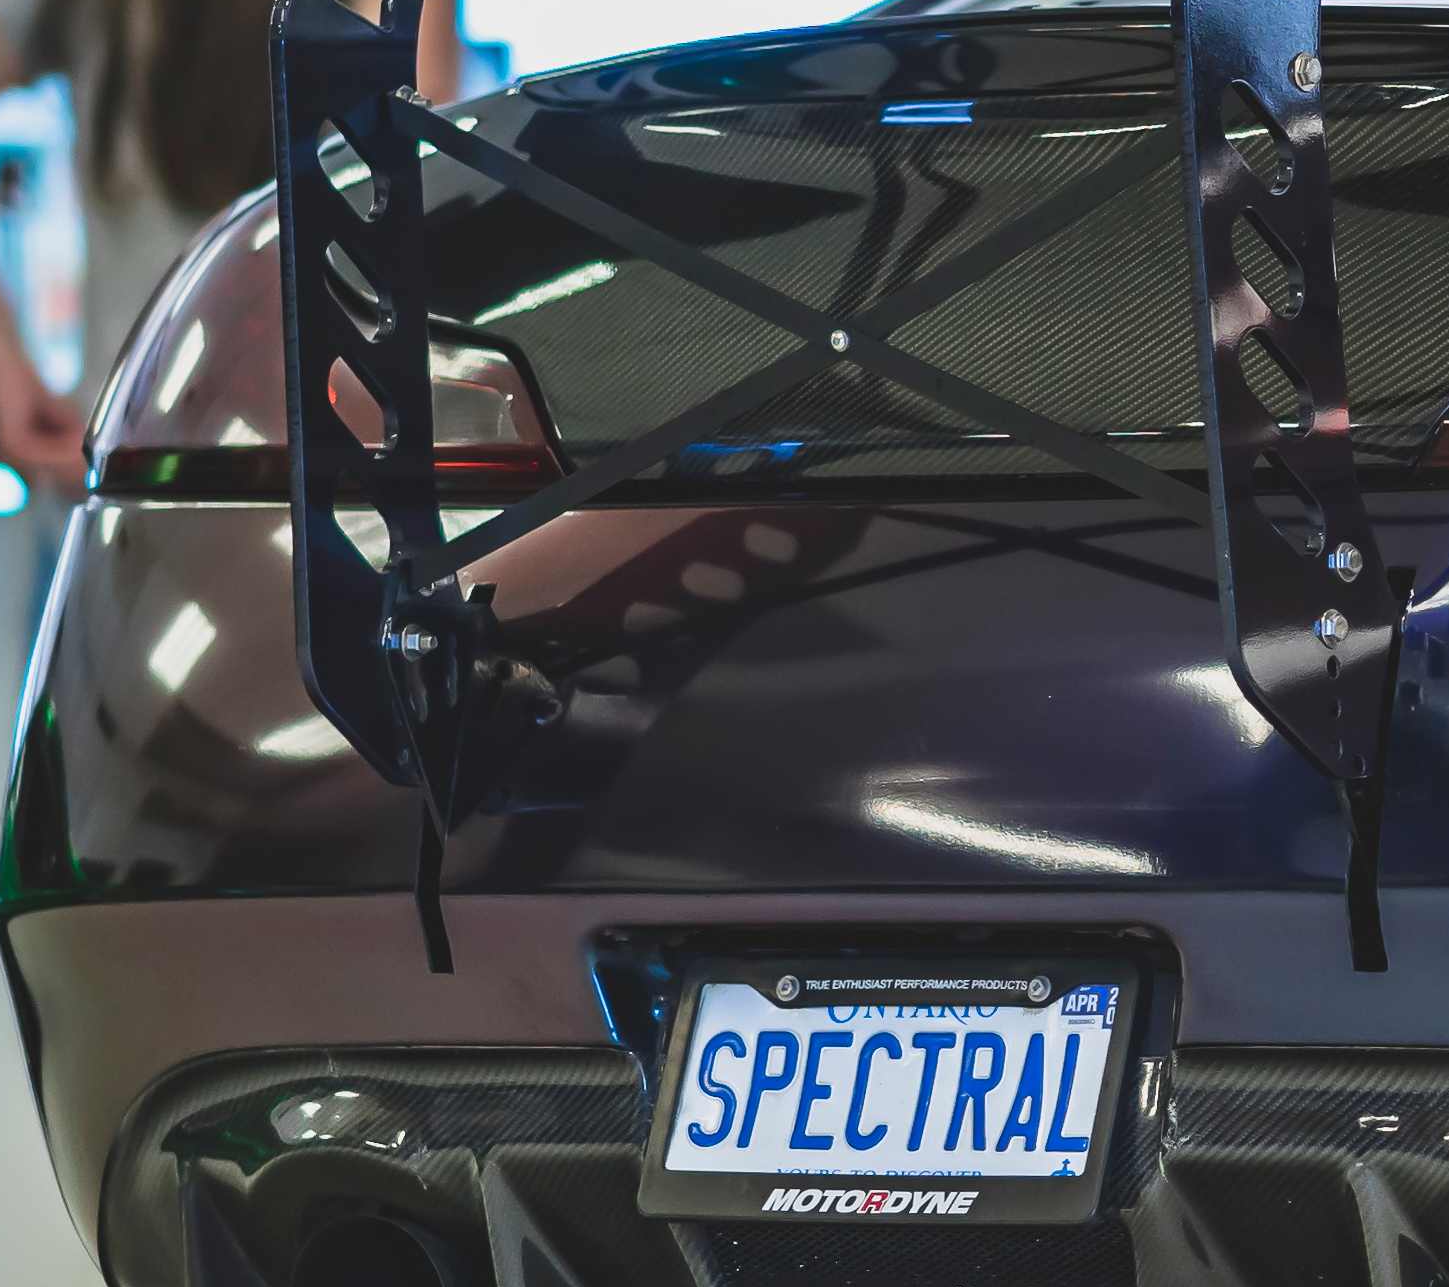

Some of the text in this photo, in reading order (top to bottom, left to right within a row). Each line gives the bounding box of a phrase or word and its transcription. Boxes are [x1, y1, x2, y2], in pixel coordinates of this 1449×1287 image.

[806, 979, 1028, 991] TRUE ENTHUSIAST PERFORMANCE PRODUCTS
[1065, 994, 1098, 1012] APR
[687, 1031, 1089, 1152] SPECTRAL
[762, 1188, 979, 1214] MOTORDYNE
